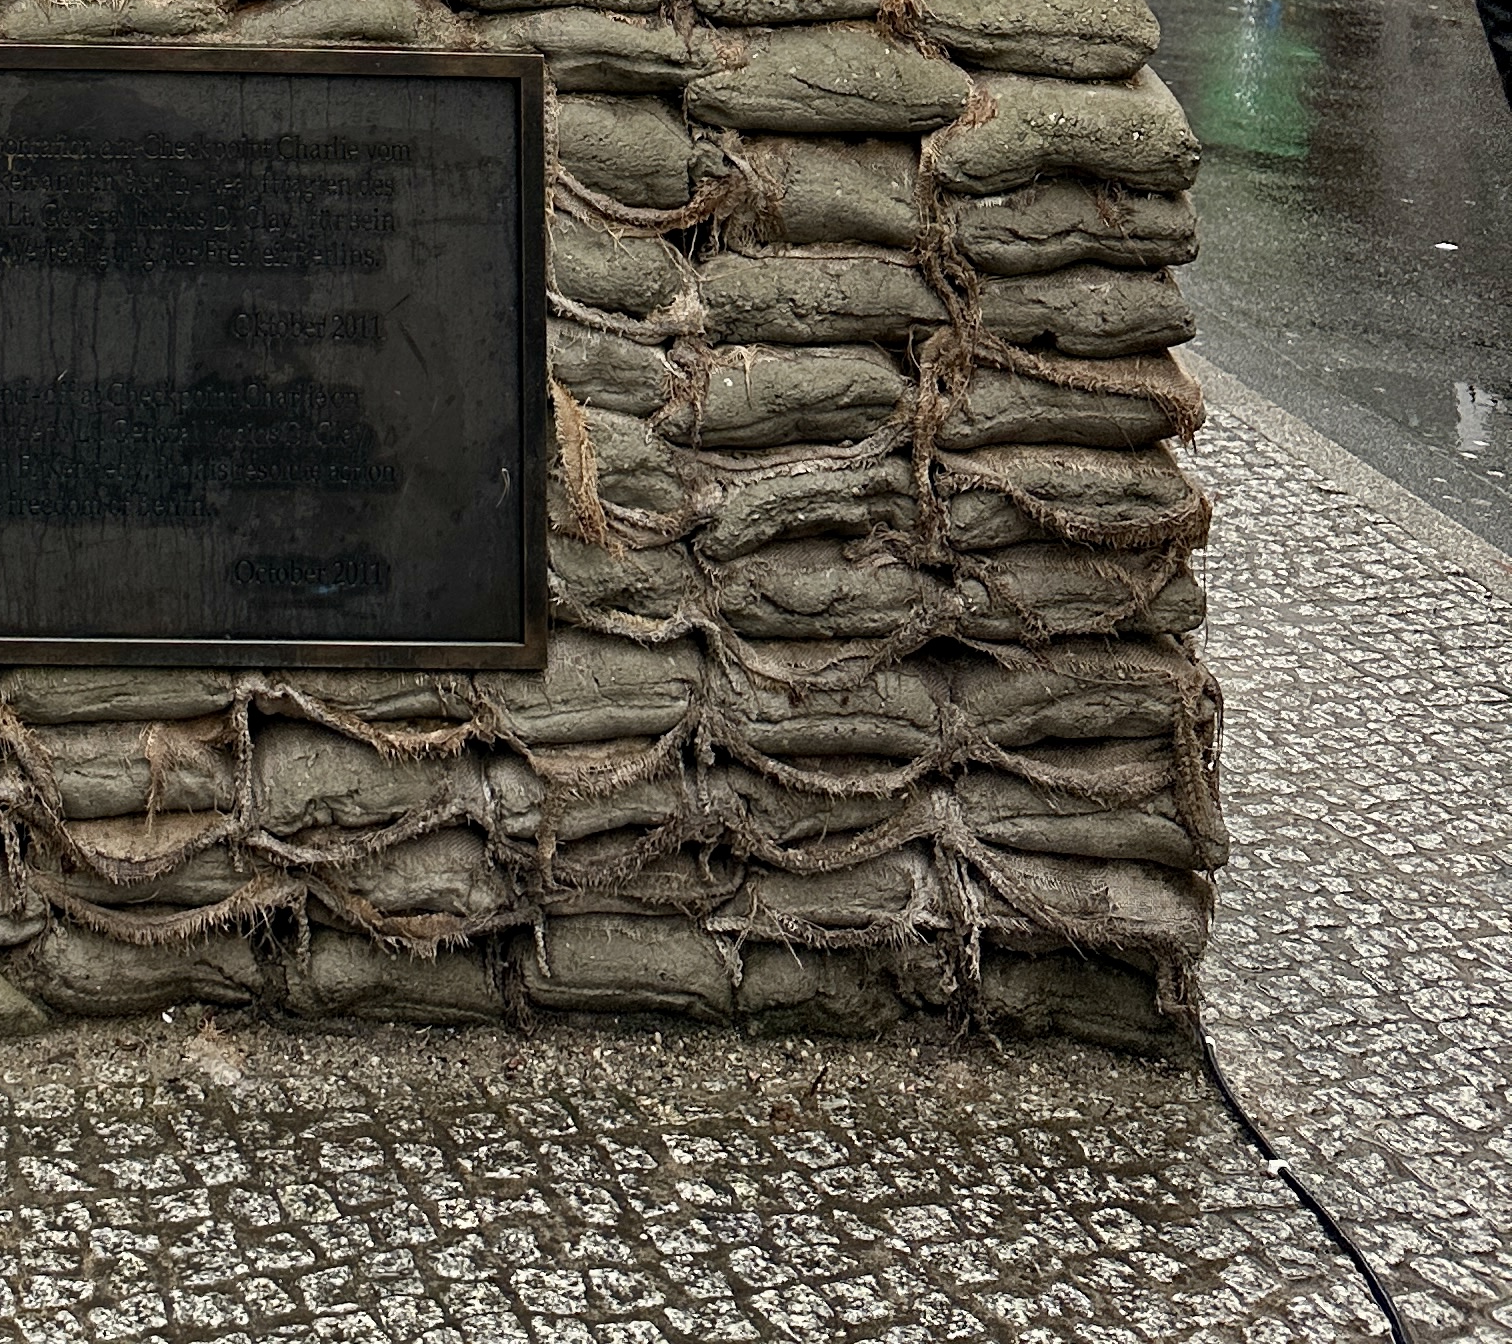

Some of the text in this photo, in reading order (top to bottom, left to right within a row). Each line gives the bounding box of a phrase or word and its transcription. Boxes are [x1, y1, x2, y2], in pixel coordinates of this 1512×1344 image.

[143, 132, 271, 165] Checkpoint
[276, 135, 360, 162] Charlie
[366, 143, 411, 162] vom
[359, 172, 395, 197] des
[232, 313, 383, 341] Oktober 2011
[234, 558, 383, 587] October 2011
